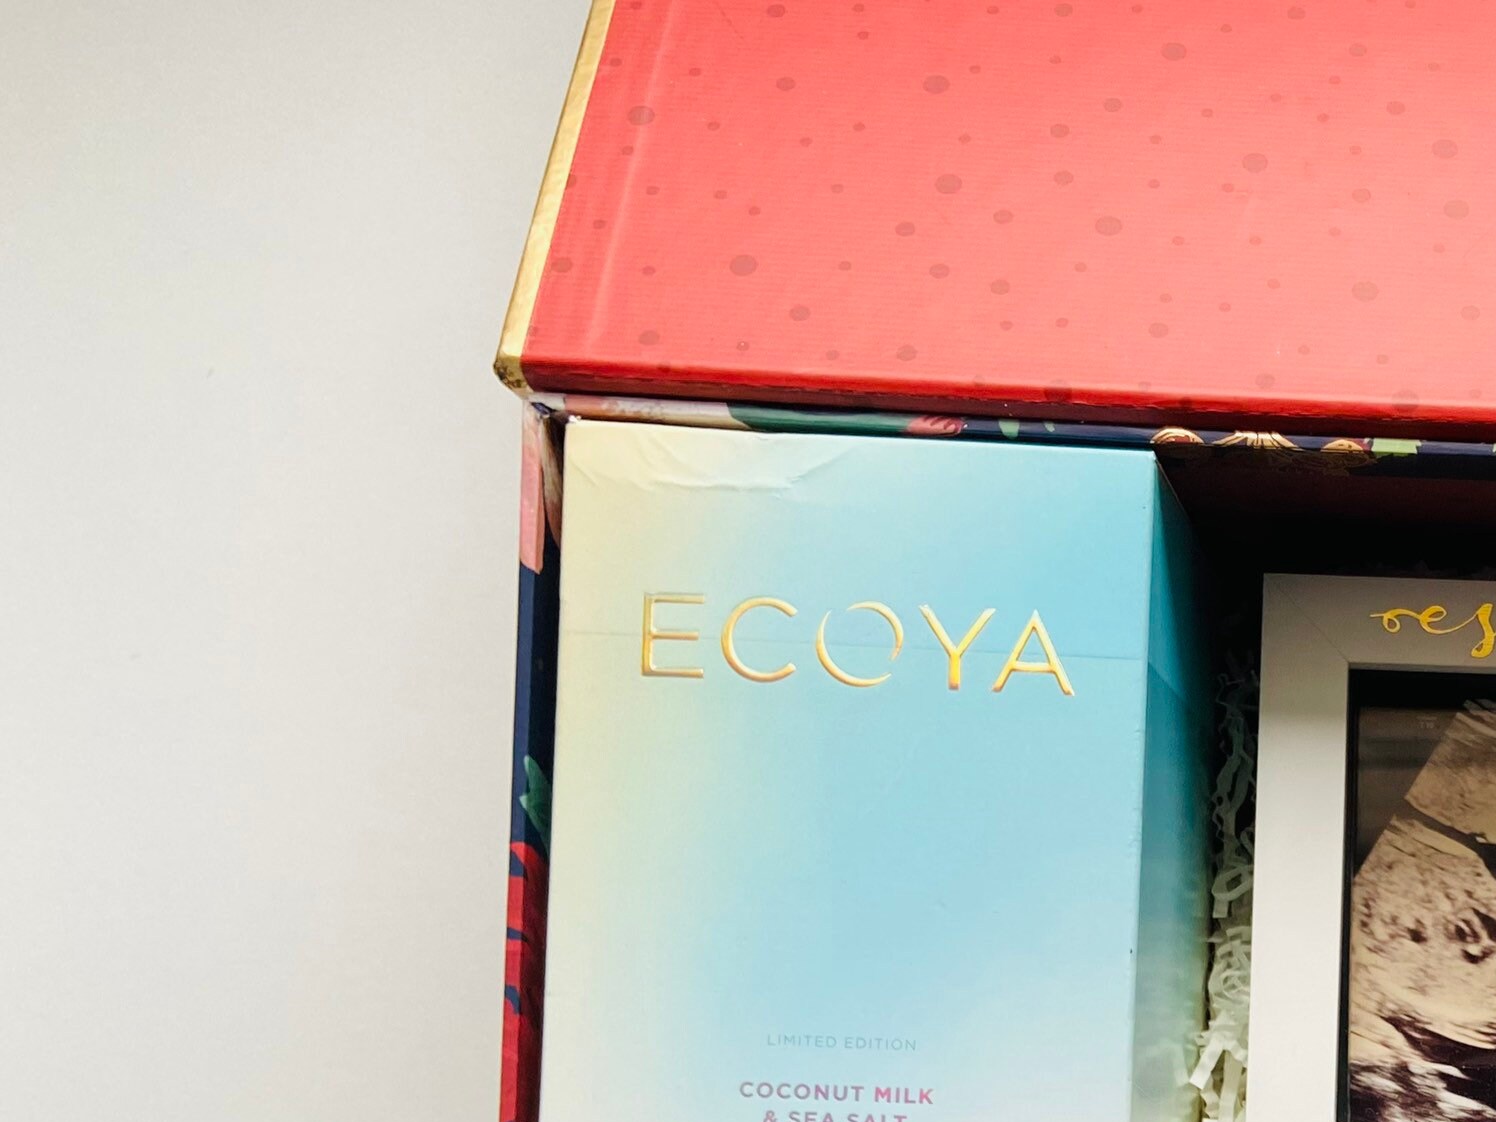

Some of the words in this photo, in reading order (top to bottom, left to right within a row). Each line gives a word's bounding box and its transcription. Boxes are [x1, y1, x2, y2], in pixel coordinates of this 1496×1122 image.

[640, 592, 1075, 697] ECOYA
[766, 1034, 838, 1049] LIMITED
[843, 1036, 917, 1051] EDITION
[739, 1081, 865, 1102] COCONUT
[874, 1086, 934, 1105] MILK
